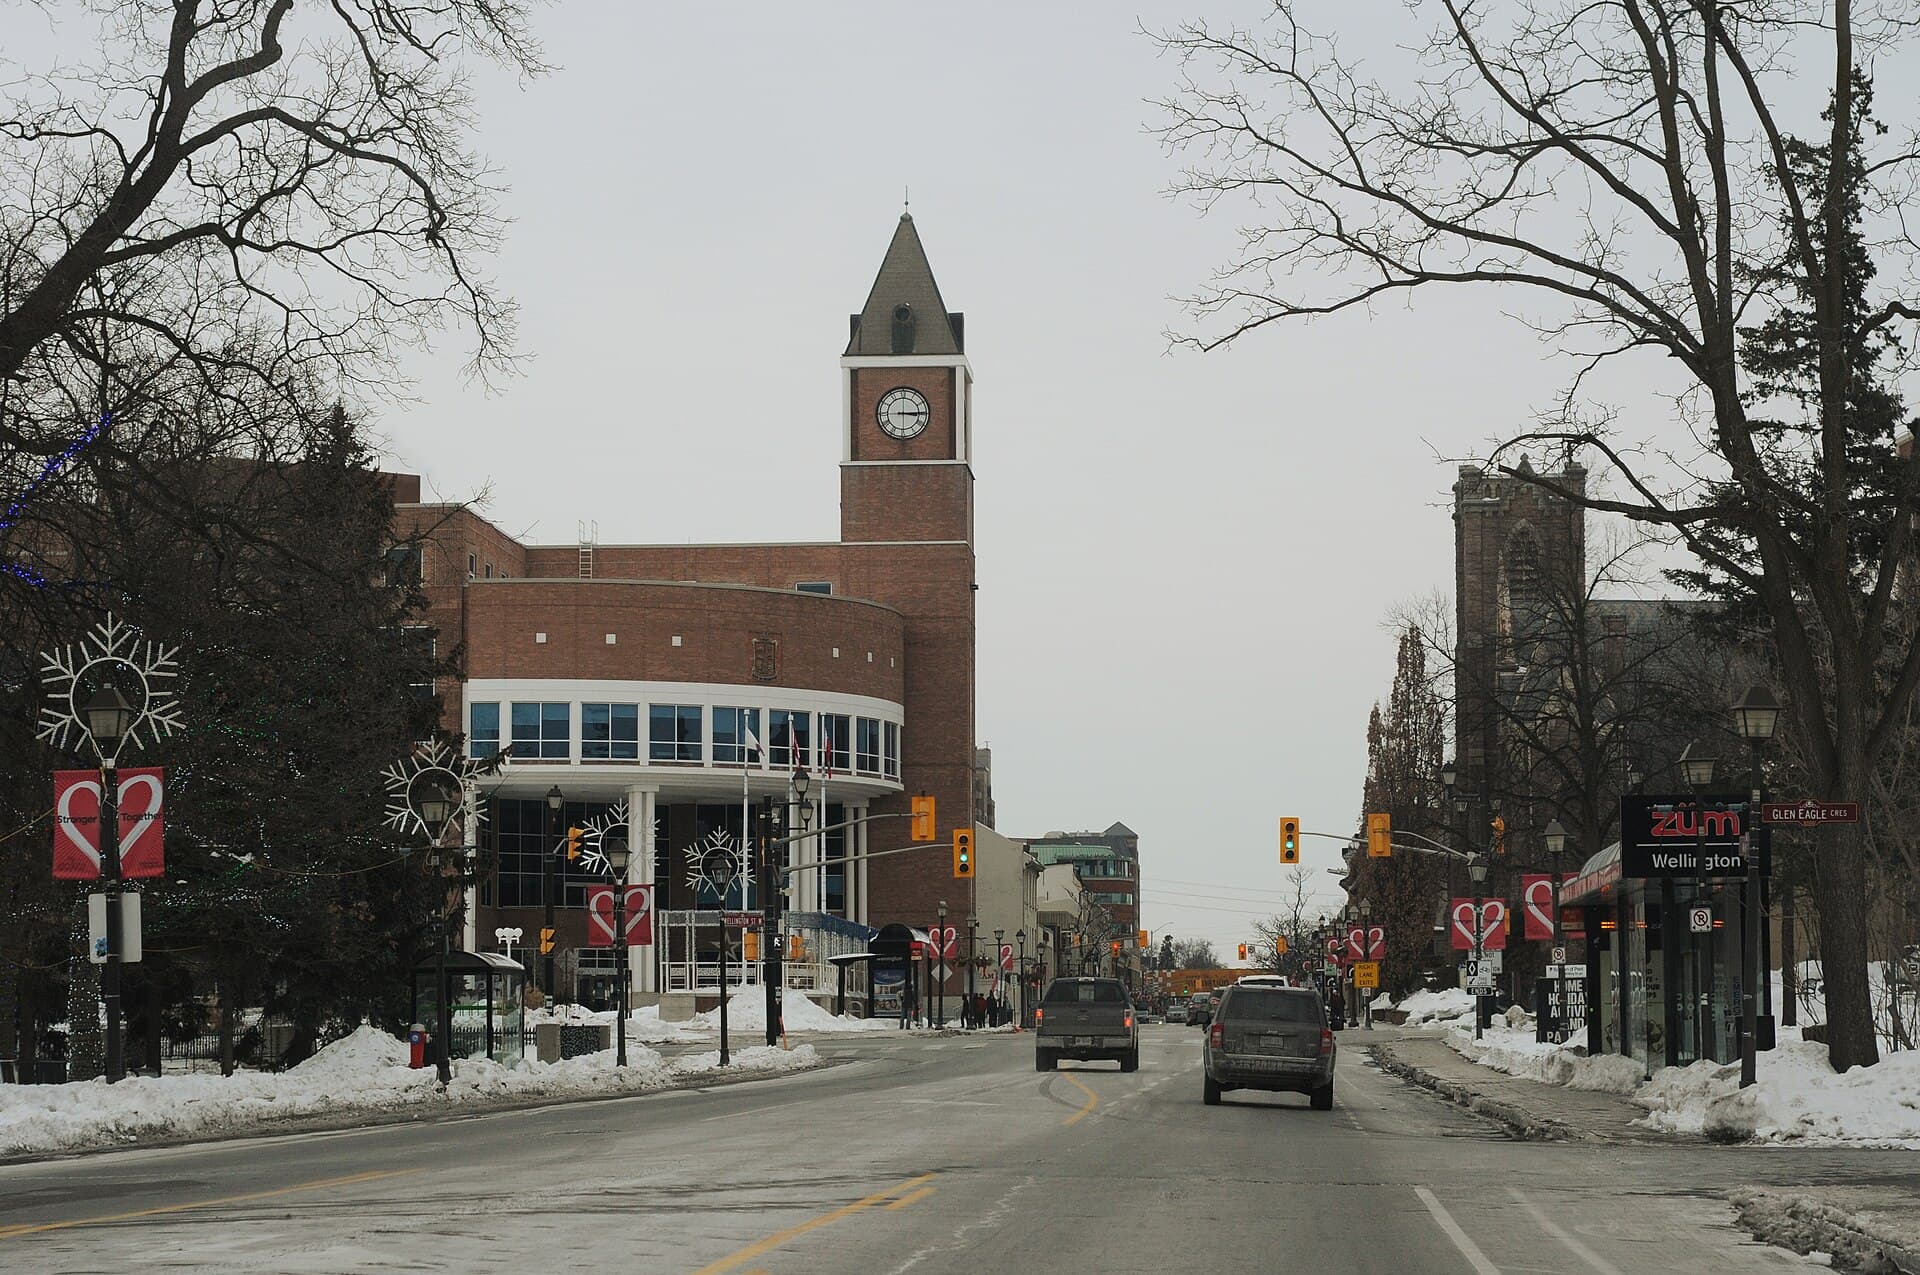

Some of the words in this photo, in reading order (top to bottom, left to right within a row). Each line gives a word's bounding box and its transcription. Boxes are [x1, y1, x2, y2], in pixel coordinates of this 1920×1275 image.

[57, 815, 98, 825] Stronger
[1772, 808, 1796, 820] GLEN
[1798, 808, 1827, 820] EAGLE
[1830, 809, 1848, 817] CRES
[1554, 980, 1583, 993] HME
